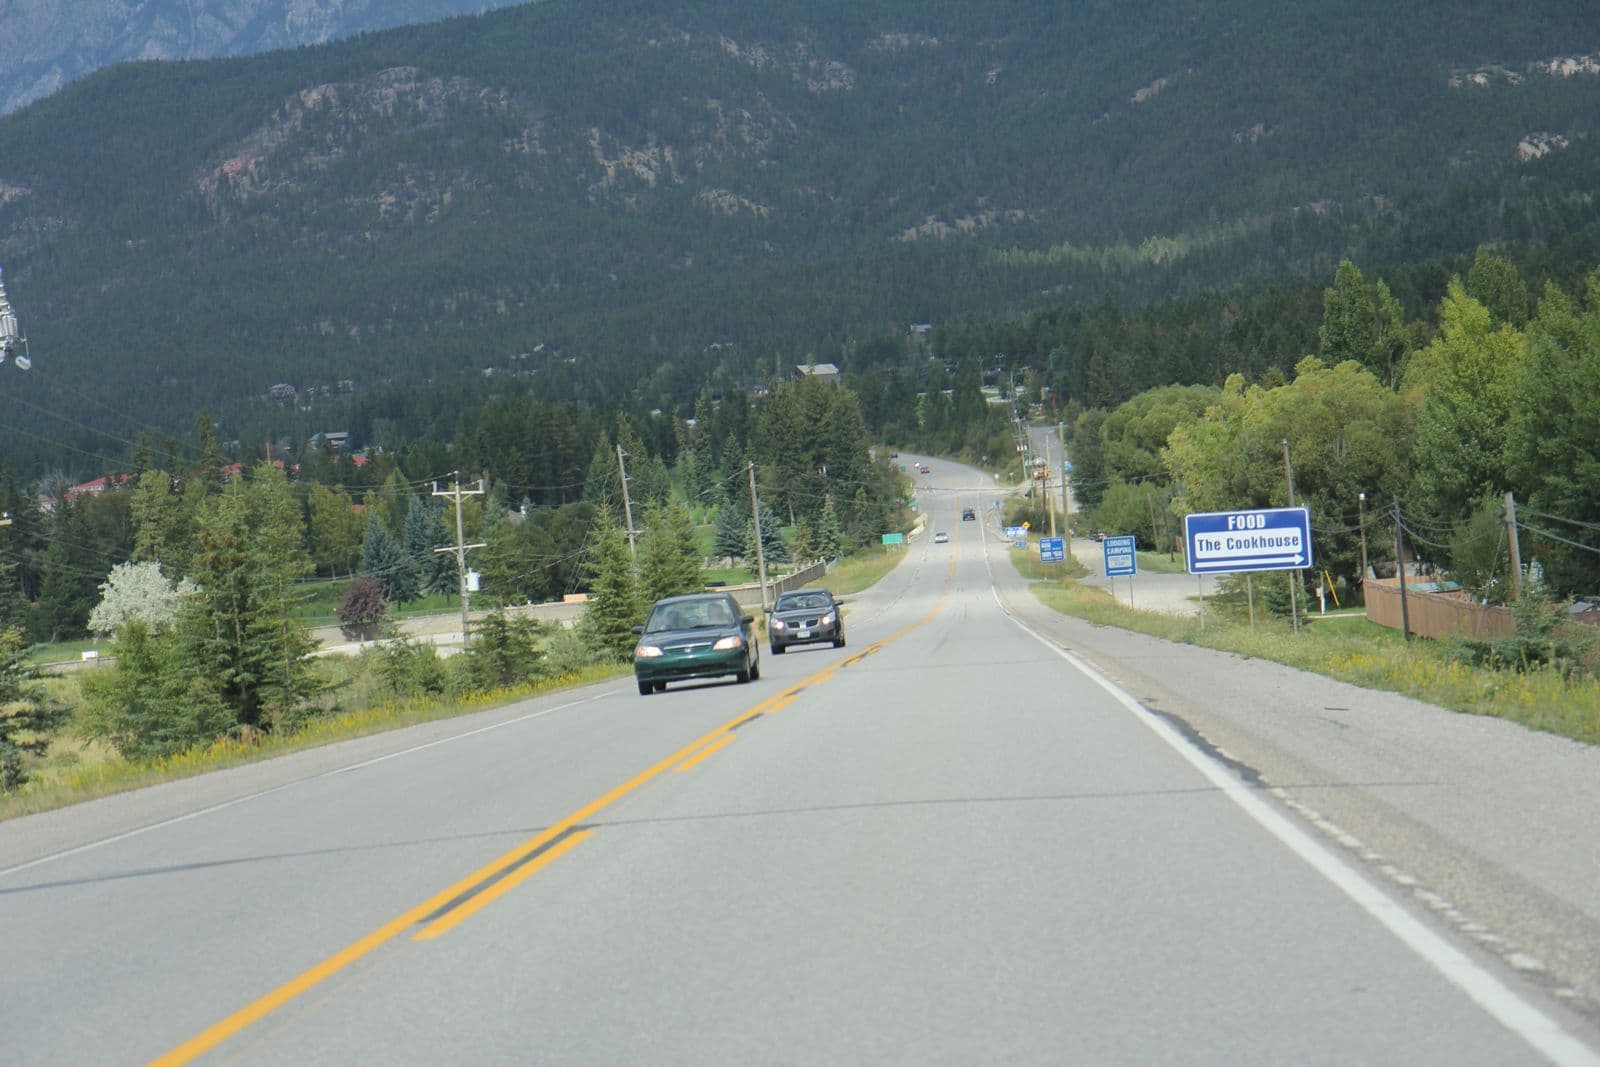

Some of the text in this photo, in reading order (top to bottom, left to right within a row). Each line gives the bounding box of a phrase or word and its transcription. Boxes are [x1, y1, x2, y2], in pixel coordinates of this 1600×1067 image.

[1228, 514, 1266, 530] FOOD
[1197, 536, 1299, 551] The Cookhouse
